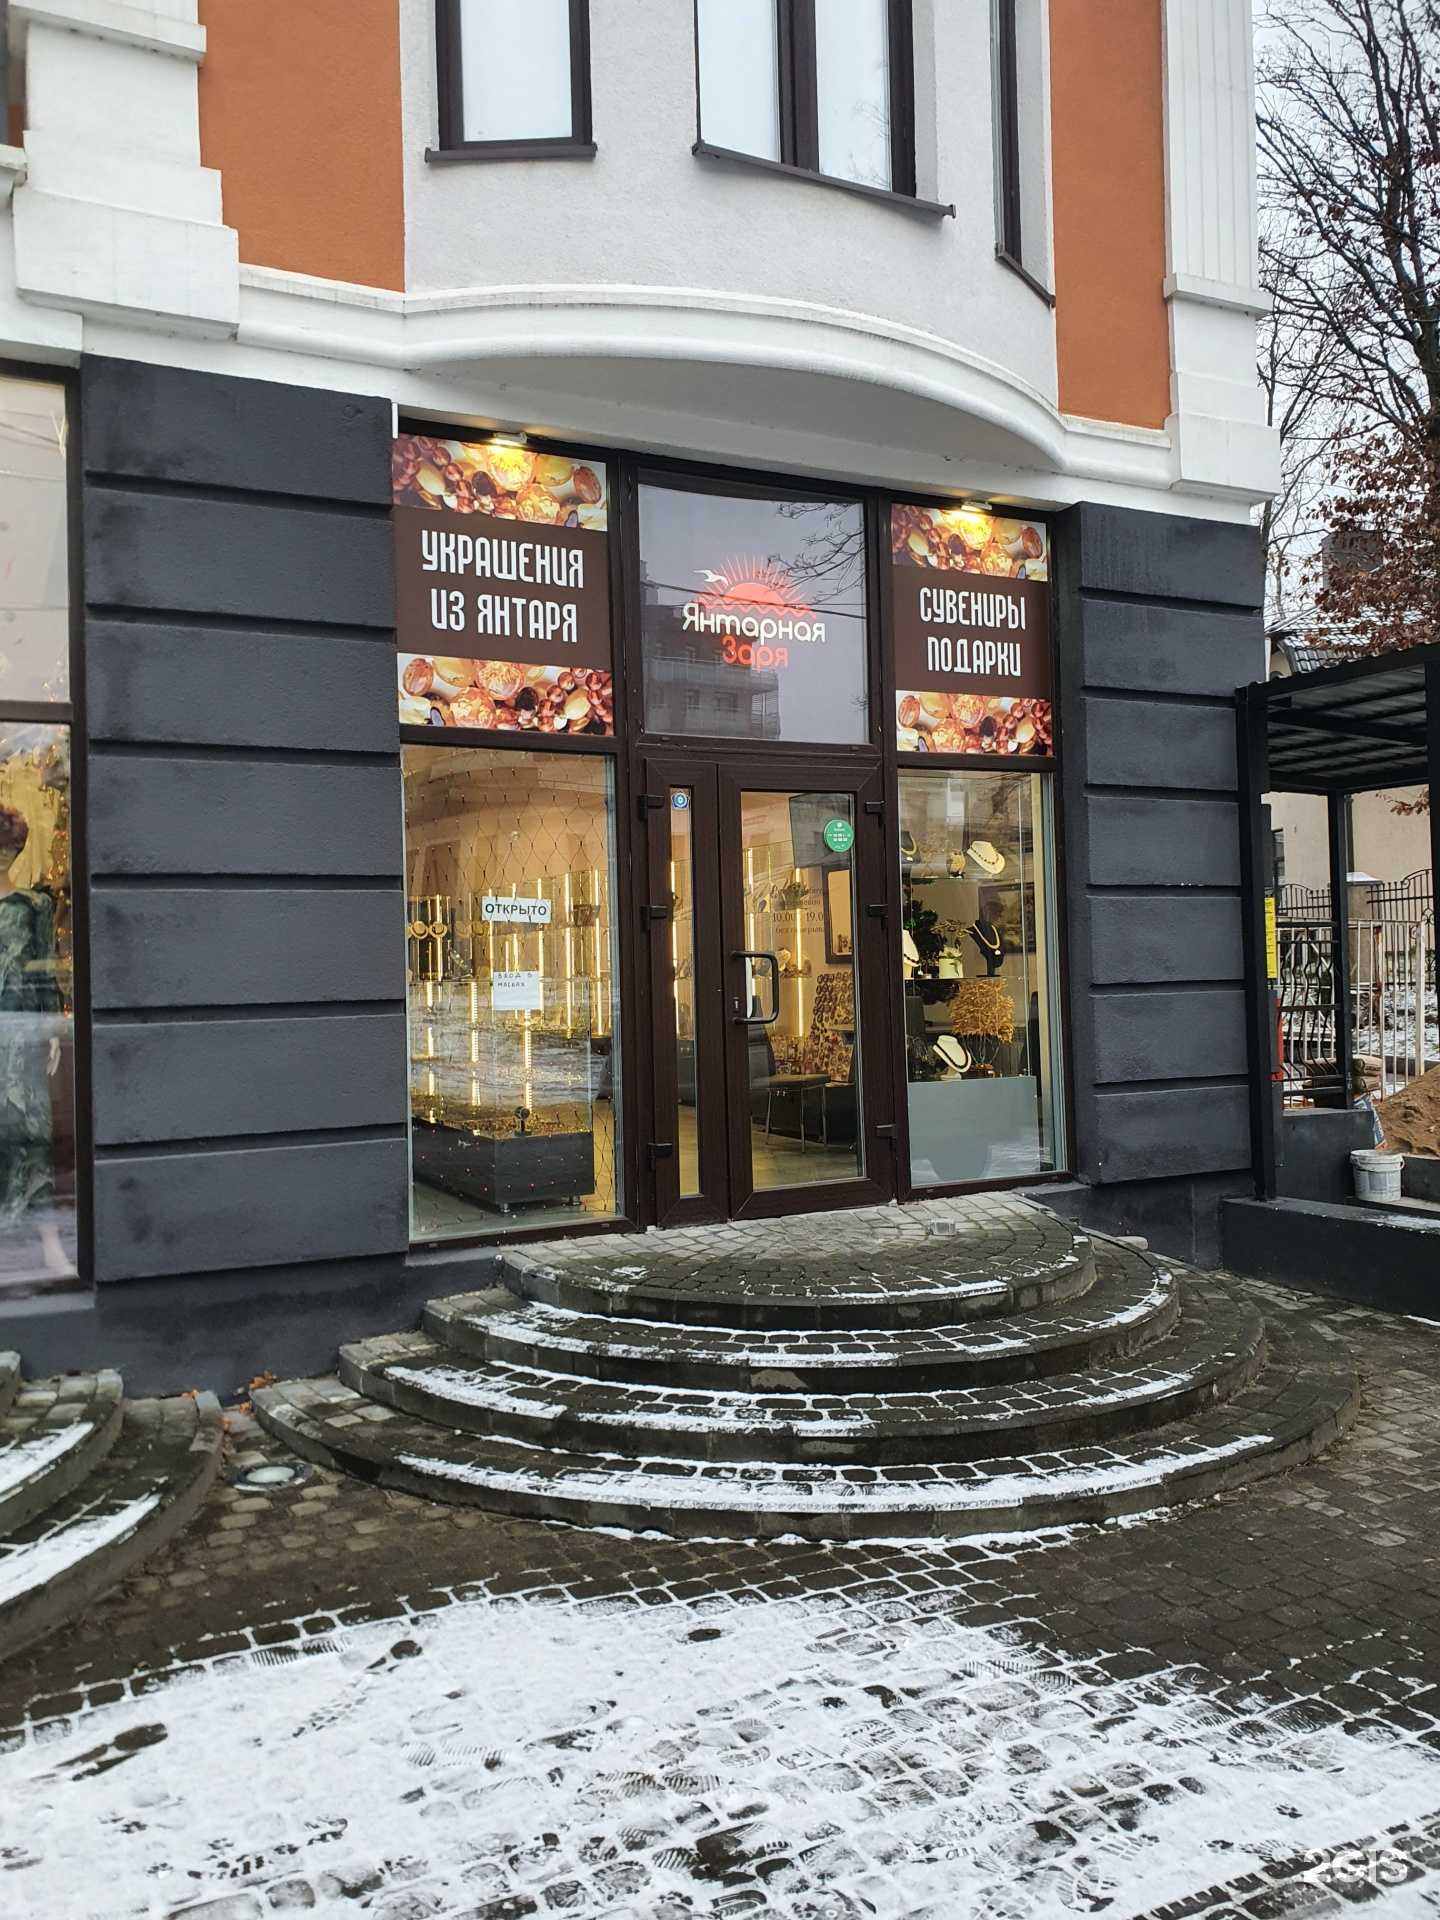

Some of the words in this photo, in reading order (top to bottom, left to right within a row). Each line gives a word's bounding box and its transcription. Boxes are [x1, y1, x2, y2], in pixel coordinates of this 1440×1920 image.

[421, 529, 585, 589] УКРАШЕНИЯ
[431, 588, 465, 632] ИЗ
[477, 594, 578, 643] ЯНТАРЯ
[682, 602, 826, 645] Янтарная
[919, 587, 1026, 630] СУВЕНИРЫ
[721, 635, 789, 673] Заря
[927, 636, 1022, 677] ПОДАРКИ
[485, 903, 547, 916] ОТКРЫТО
